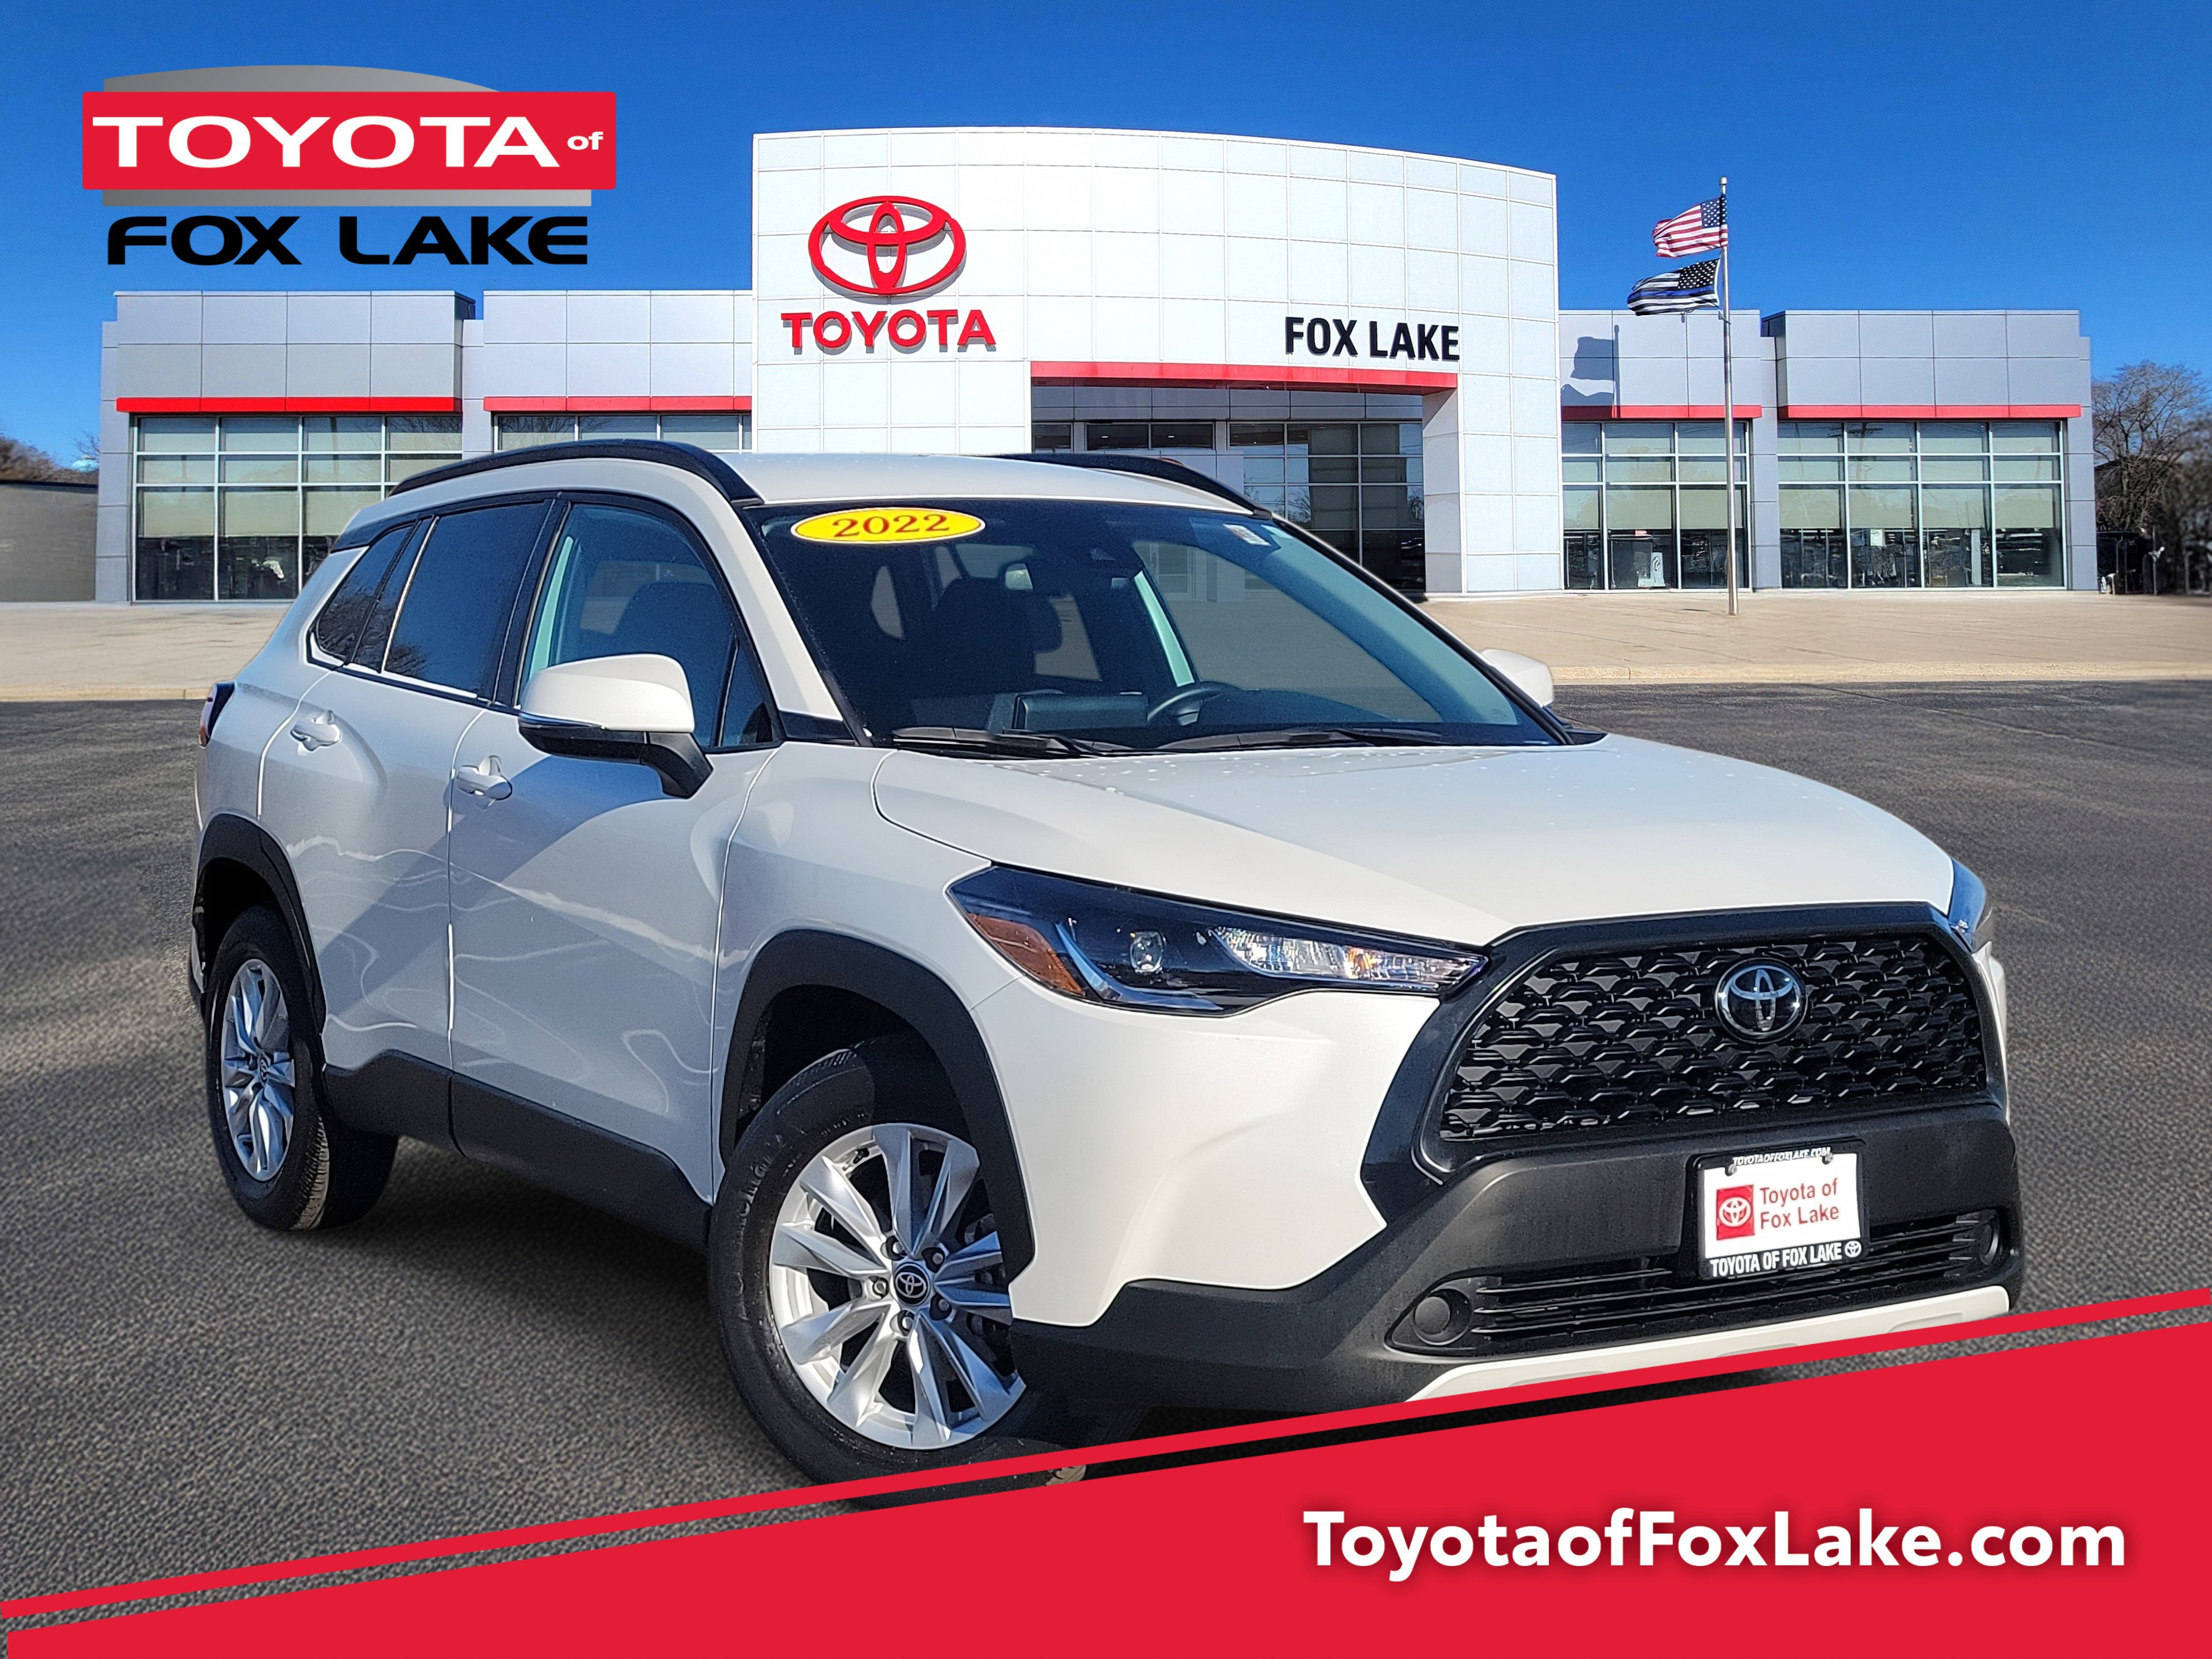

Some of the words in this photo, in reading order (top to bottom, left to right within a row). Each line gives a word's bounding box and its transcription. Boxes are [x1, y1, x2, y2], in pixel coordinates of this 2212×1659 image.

[781, 309, 997, 354] TOYOTA
[1285, 316, 1359, 357] FOX
[1369, 320, 1460, 362] LAKE
[832, 514, 950, 537] 2022
[1759, 1183, 1815, 1207] Toyota
[1822, 1177, 1838, 1196] of
[1760, 1212, 1792, 1230] Fox
[1798, 1203, 1839, 1224] Lake
[1710, 1253, 1761, 1277] TOYOTA
[1762, 1251, 1780, 1270] OF
[1781, 1246, 1808, 1267] FOX
[1809, 1242, 1843, 1263] LAKE
